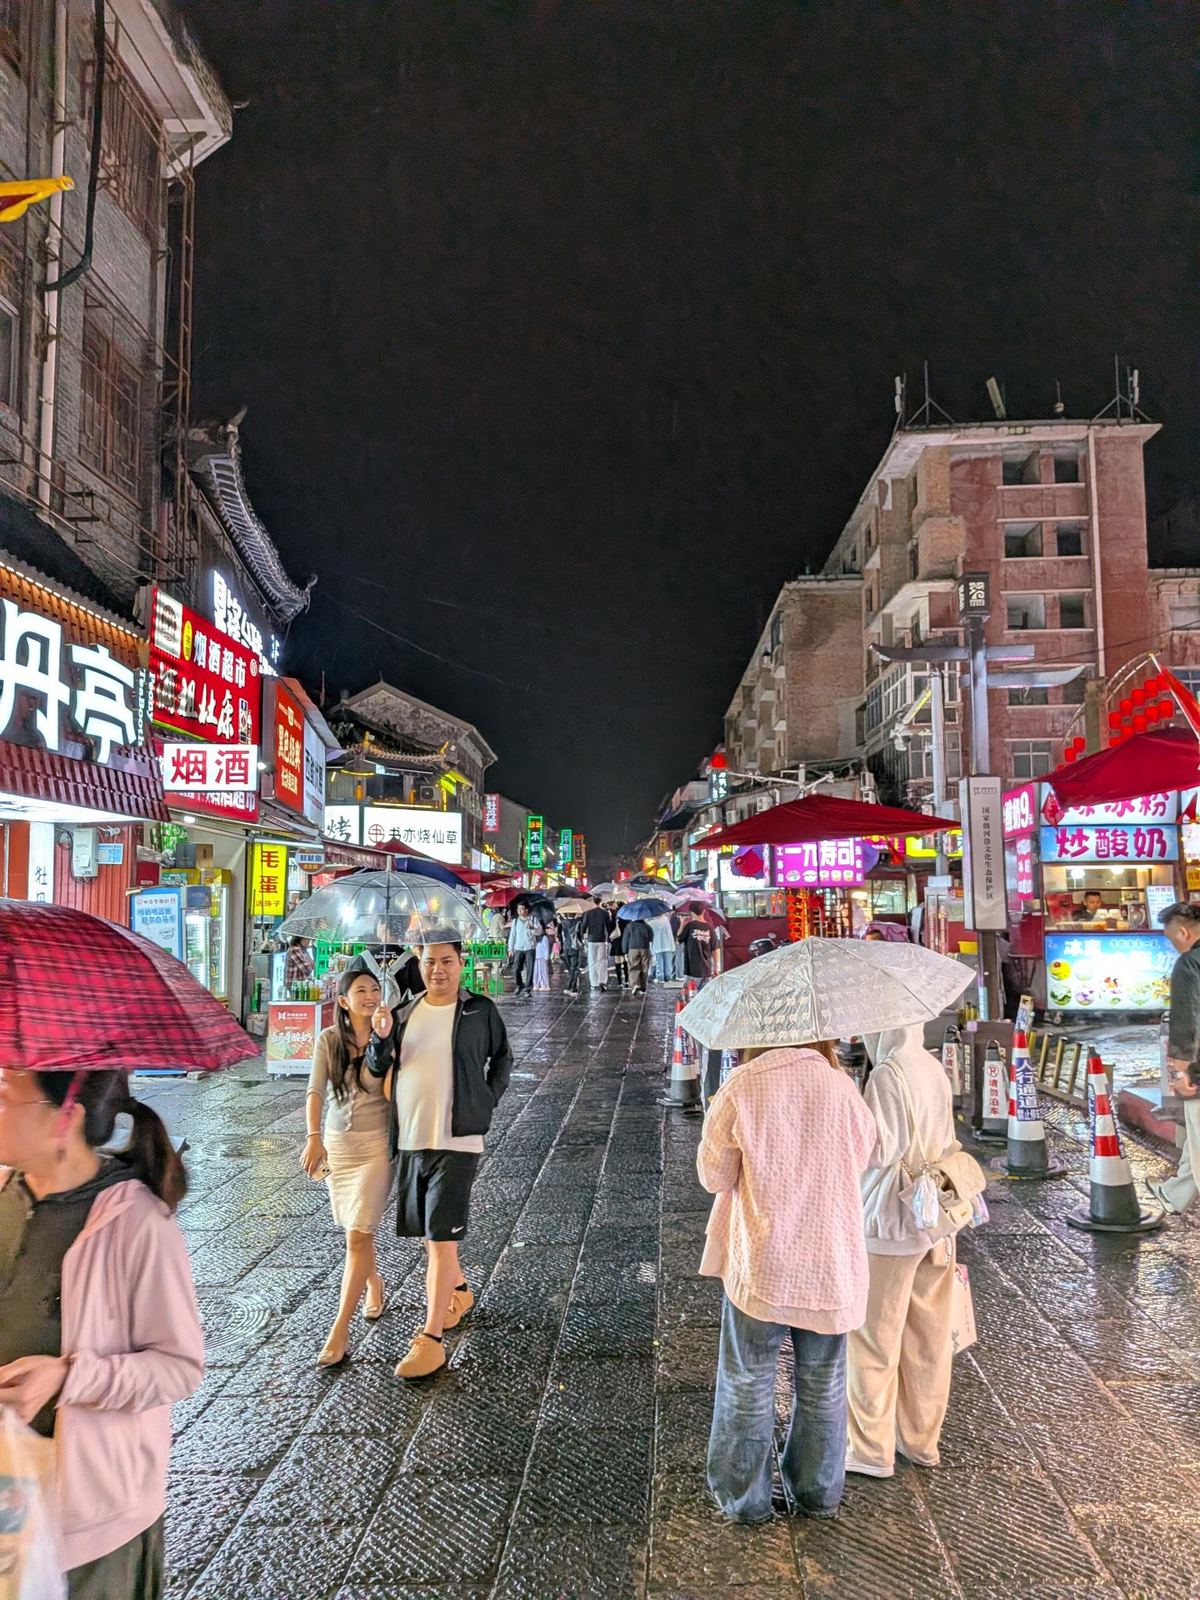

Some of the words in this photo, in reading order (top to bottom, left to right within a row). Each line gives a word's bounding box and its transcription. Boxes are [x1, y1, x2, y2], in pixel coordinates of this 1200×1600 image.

[194, 630, 247, 688] 烟酒超市
[171, 748, 250, 785] 烟酒
[388, 827, 458, 845] 书亦烧仙草
[784, 837, 855, 867] 一九寿司
[1056, 828, 1168, 858] 炒酸奶
[259, 850, 280, 893] 毛蛋
[988, 1079, 1001, 1116] 请勿泊车
